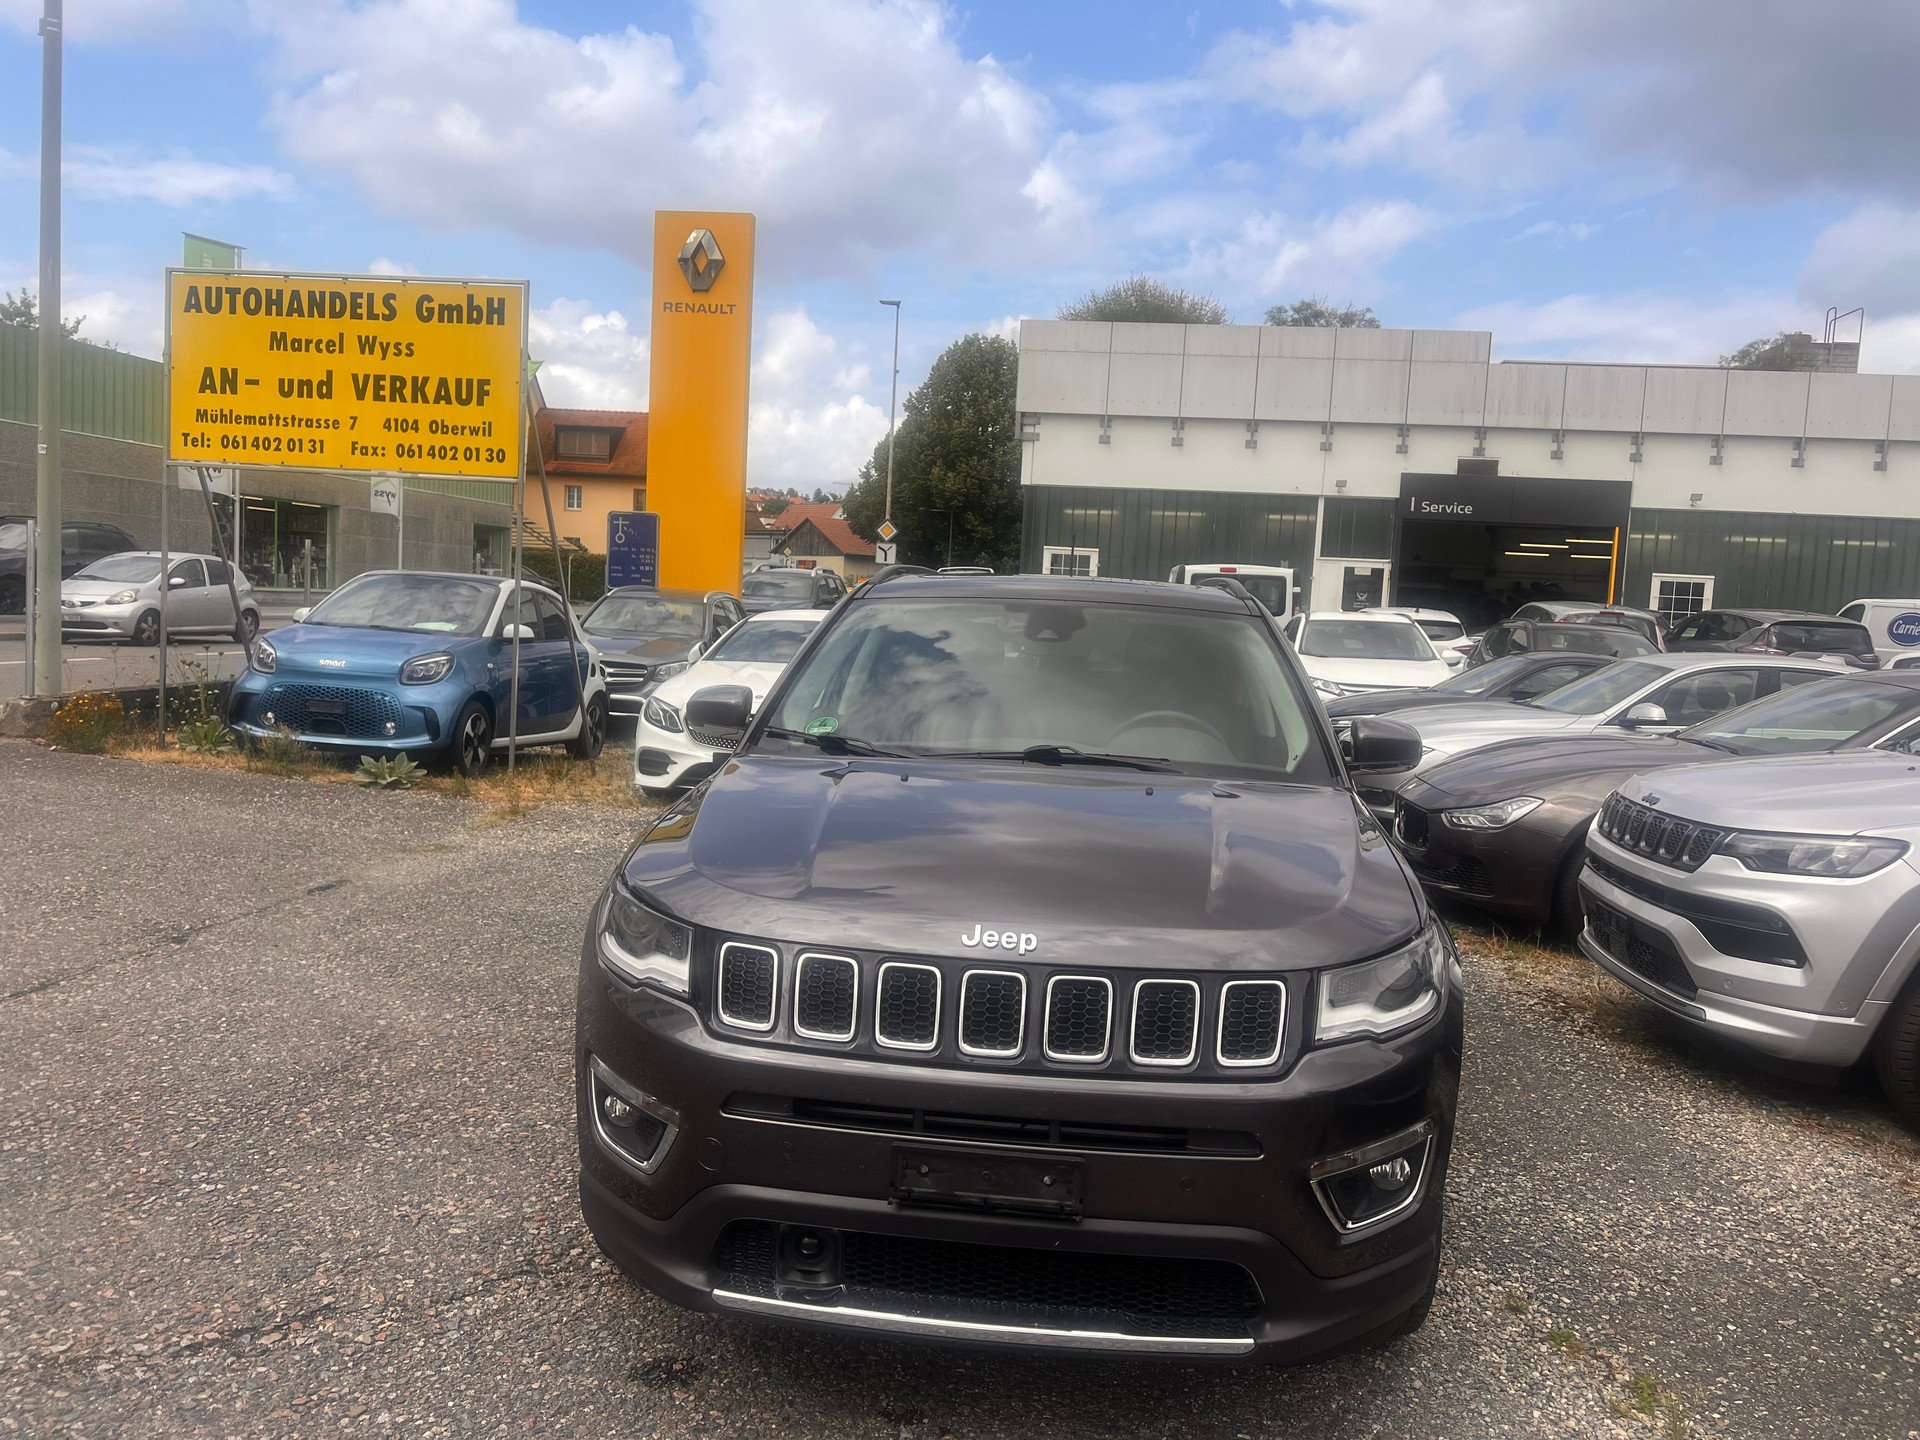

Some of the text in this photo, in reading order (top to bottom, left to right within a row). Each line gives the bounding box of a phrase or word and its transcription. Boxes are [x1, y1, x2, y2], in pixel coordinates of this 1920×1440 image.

[183, 285, 506, 326] AUTOHANDELS GmbH
[663, 302, 736, 315] RENAULT
[268, 330, 415, 361] Marcel Wyss
[278, 369, 334, 400] und
[350, 372, 491, 407] VERKAUF
[195, 408, 493, 438] Mühlemattstrasse 7 4104 Oberwil
[181, 431, 211, 448] Tel:
[350, 441, 386, 458] Fax:
[1421, 501, 1473, 514] Service
[319, 659, 346, 667] smart
[961, 923, 1038, 956] Jeep
